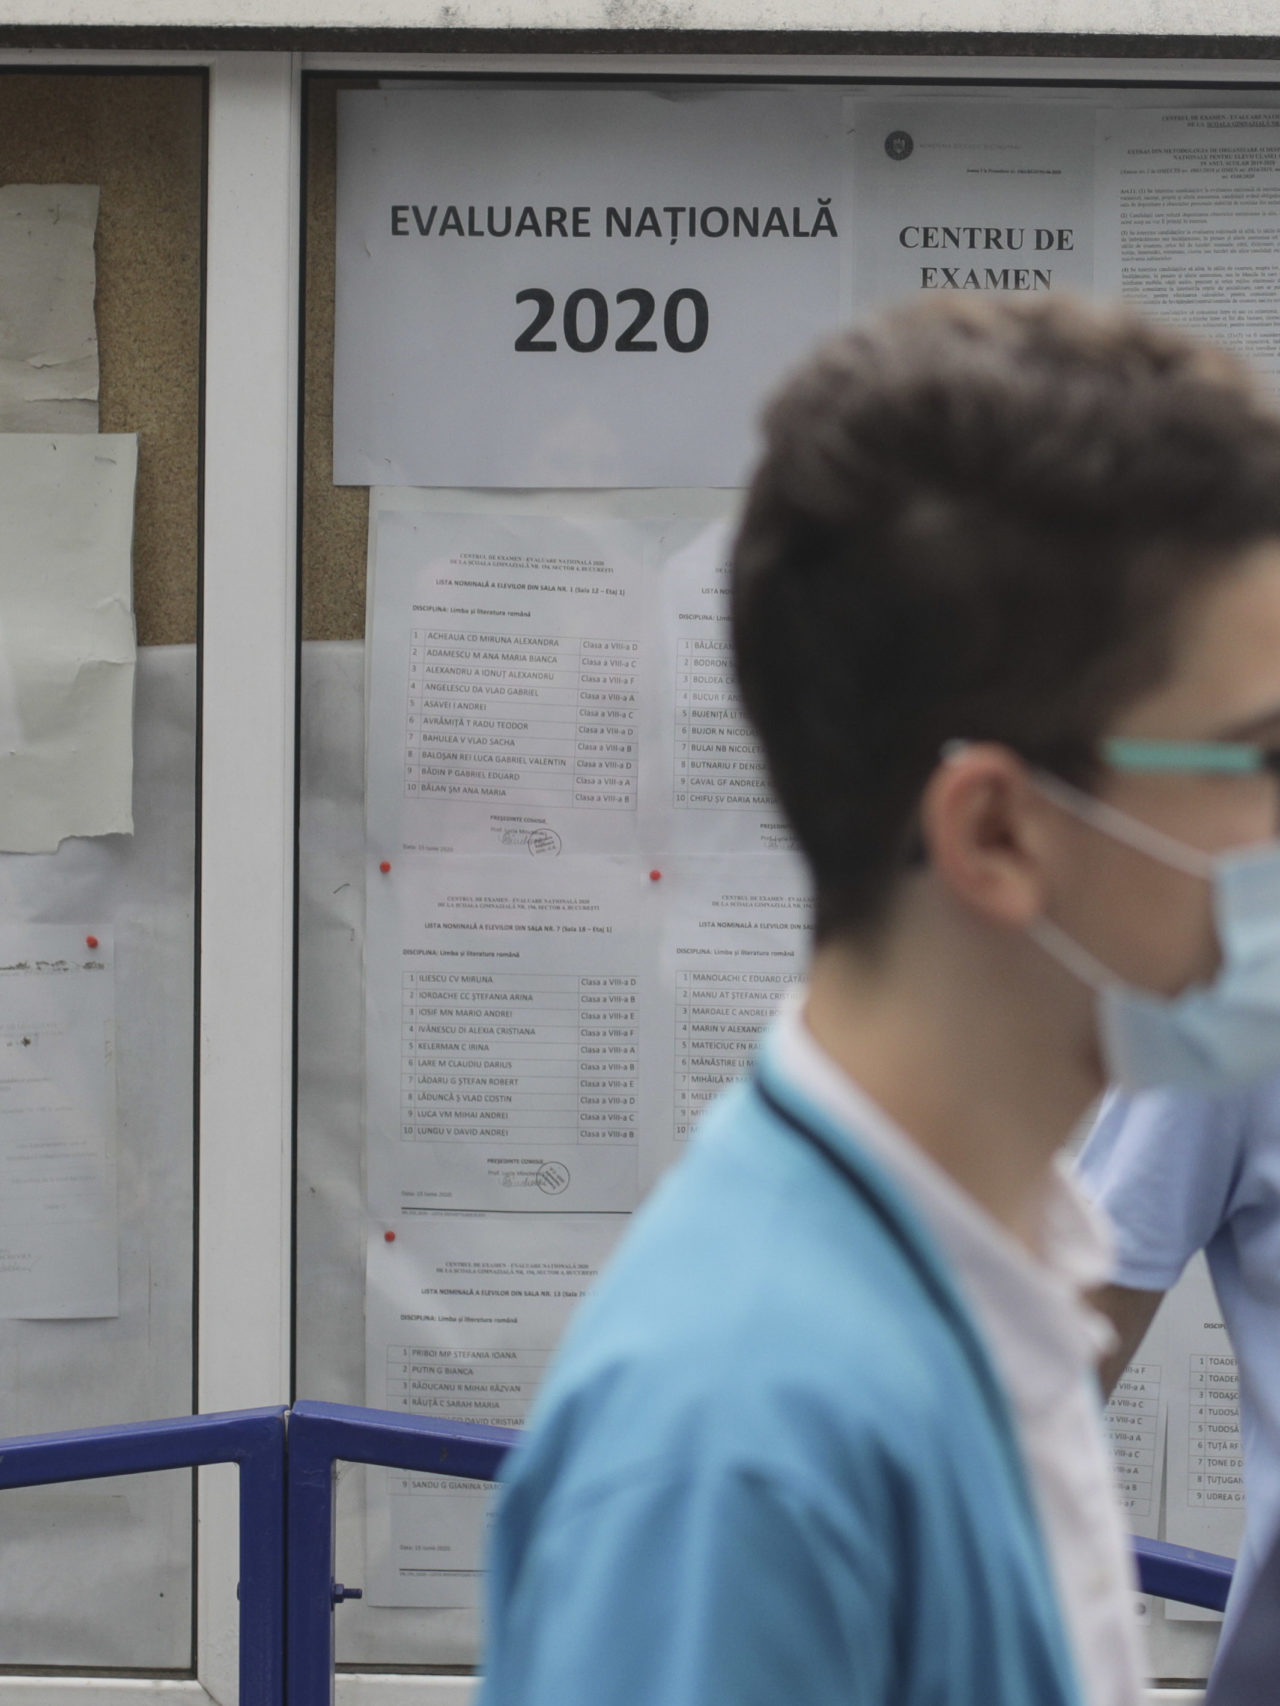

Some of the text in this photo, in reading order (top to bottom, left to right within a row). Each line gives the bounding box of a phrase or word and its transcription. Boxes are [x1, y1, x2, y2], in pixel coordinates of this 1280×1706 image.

[391, 198, 838, 245] EVALUARE NAȚIONALĂ
[899, 226, 1074, 251] CENTRU DE
[921, 267, 1052, 291] EXAMEN
[514, 287, 710, 353] 2020
